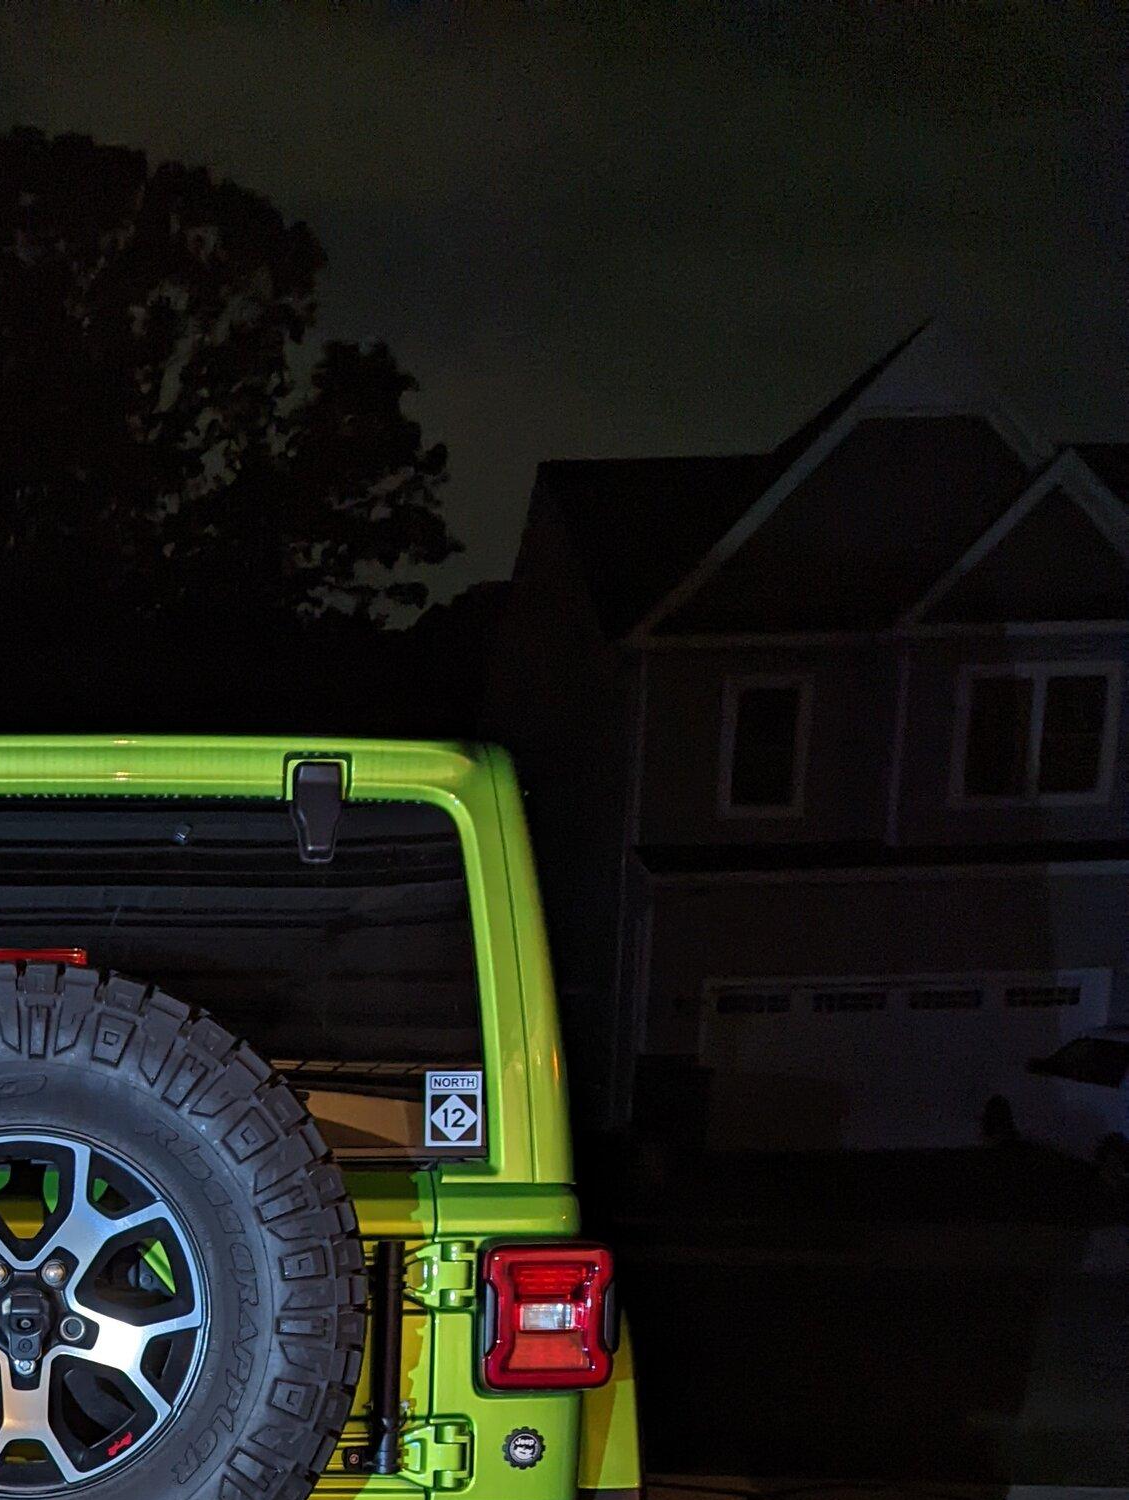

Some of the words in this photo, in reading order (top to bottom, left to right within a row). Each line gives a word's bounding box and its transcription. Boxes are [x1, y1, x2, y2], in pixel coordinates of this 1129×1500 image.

[434, 1078, 475, 1087] NORTH
[442, 1108, 466, 1128] 12
[515, 1438, 534, 1446] Jeep
